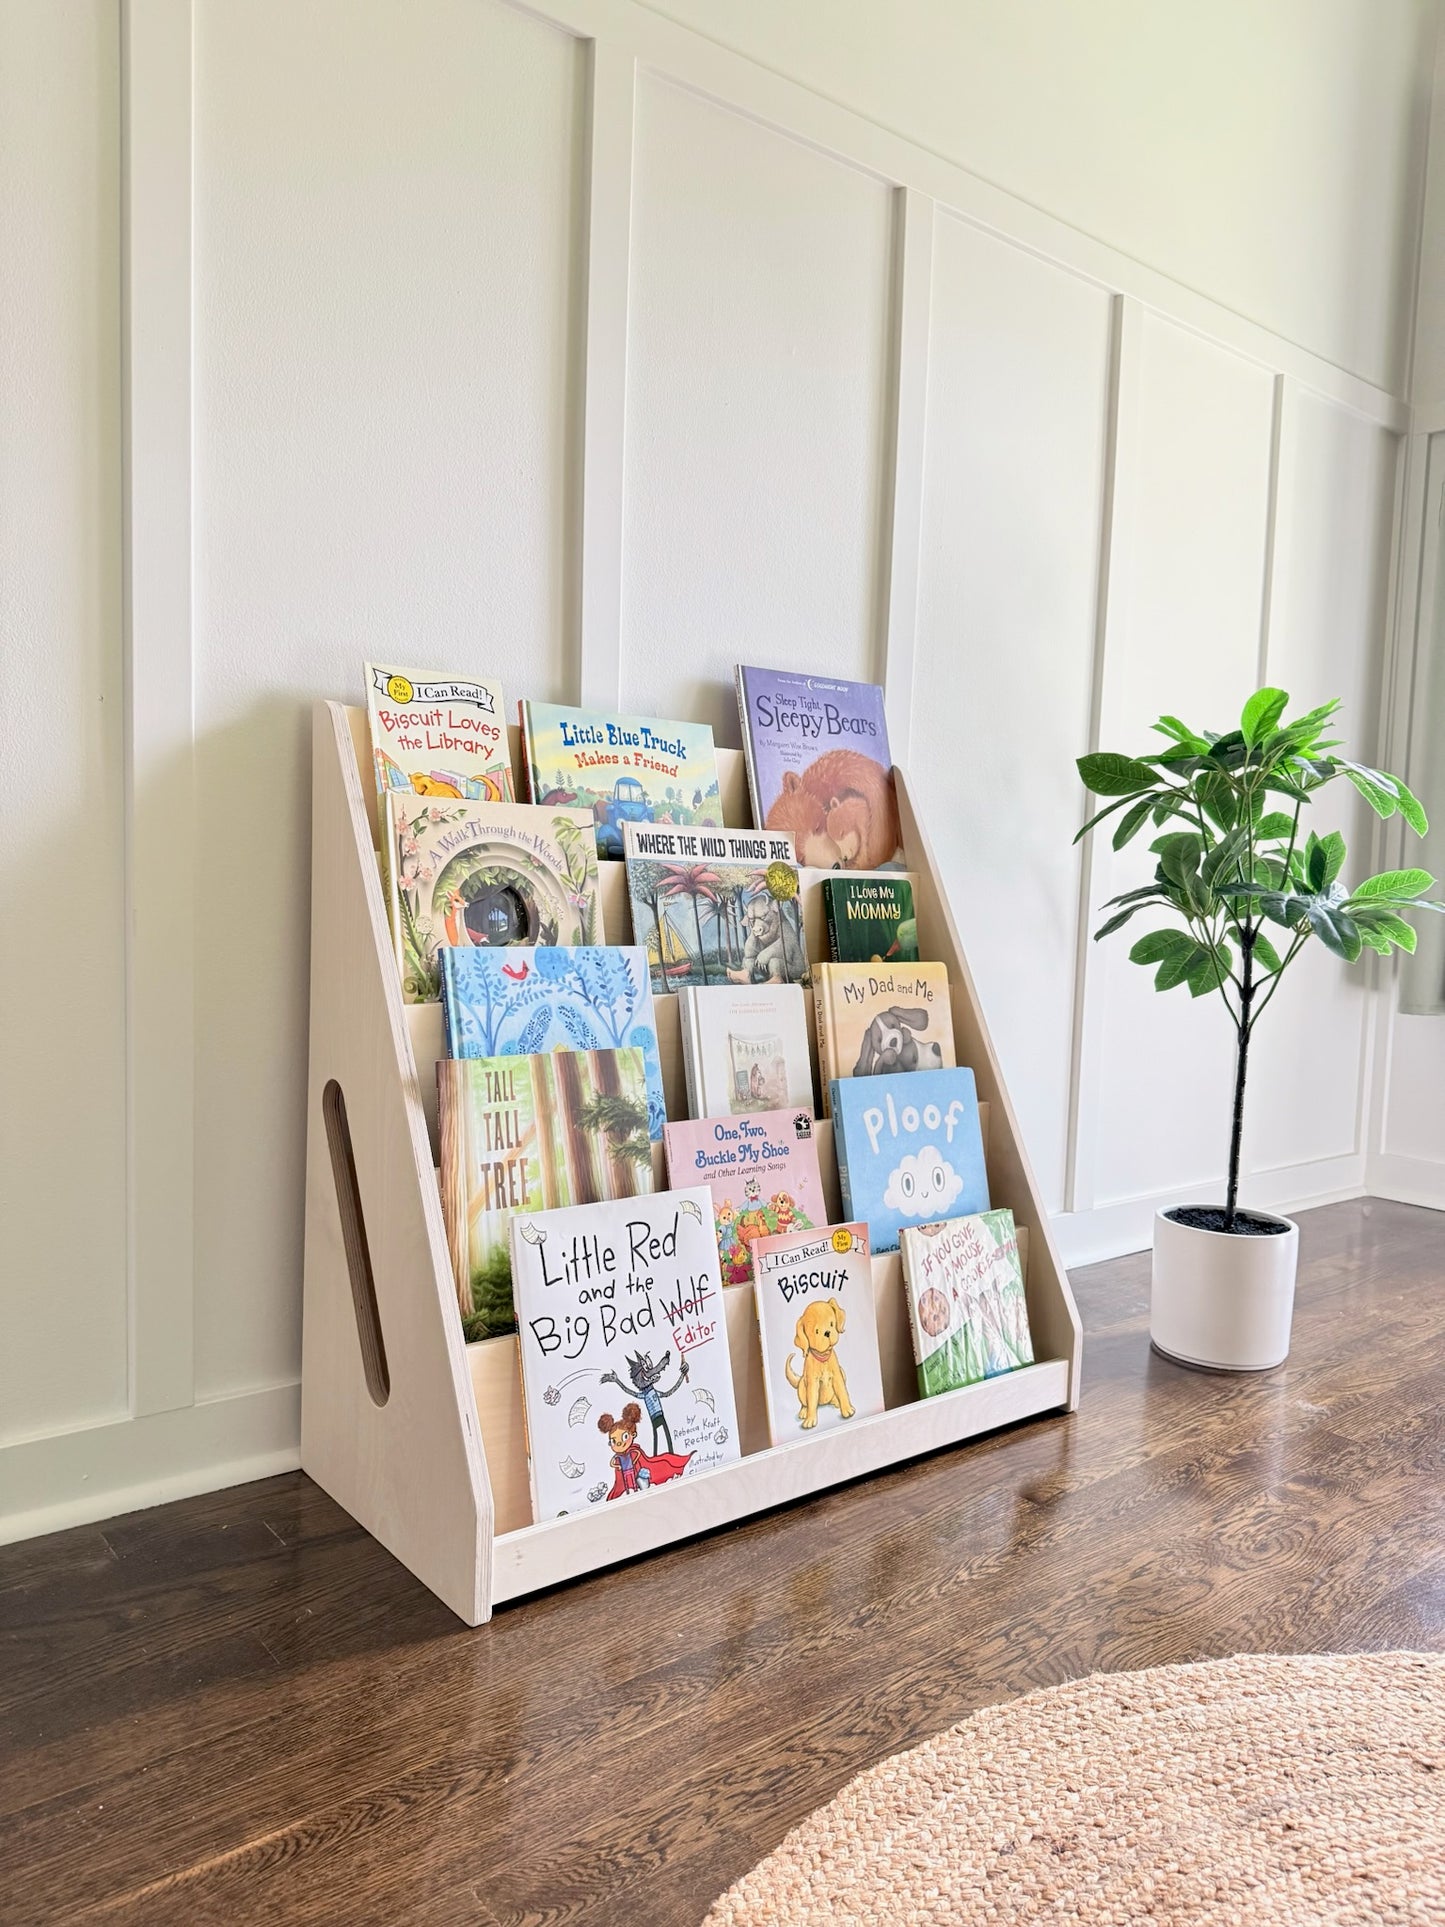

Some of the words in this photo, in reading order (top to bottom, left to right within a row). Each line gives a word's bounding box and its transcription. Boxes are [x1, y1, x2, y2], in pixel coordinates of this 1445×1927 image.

[417, 687, 421, 698] I
[425, 687, 448, 699] Can
[450, 686, 483, 700] Read!
[775, 693, 797, 710] Sleep
[379, 709, 443, 732] Biscuit
[449, 710, 500, 741] Loves
[756, 695, 823, 738] Sleepy
[824, 703, 877, 737] Bears
[397, 734, 422, 750] the
[426, 731, 494, 760] Library
[560, 722, 603, 746] Little
[606, 723, 640, 746] Blue
[640, 727, 687, 759] Truck
[574, 751, 619, 769] Makes
[623, 754, 631, 765] a
[634, 752, 678, 778] Friend
[428, 849, 442, 869] A
[437, 830, 470, 852] Walk
[466, 818, 516, 842] Through
[518, 831, 533, 844] the
[532, 835, 565, 872] Woods
[636, 833, 676, 855] WHERE
[677, 836, 697, 856] THE
[700, 837, 726, 858] WILD
[729, 839, 767, 859] THINGS
[769, 841, 791, 860] ARE
[850, 886, 855, 899] I
[843, 982, 865, 1004] My
[869, 976, 895, 996] Dad
[897, 983, 913, 994] and
[915, 979, 934, 1002] Me
[485, 1070, 516, 1103] TALL
[483, 1109, 523, 1152] TALL
[715, 1124, 741, 1141] One,
[740, 1121, 767, 1138] Two,
[863, 1092, 964, 1155] ploof
[695, 1151, 736, 1168] Buckle
[738, 1144, 760, 1163] My
[761, 1141, 790, 1159] Shoe
[481, 1157, 531, 1211] TREE
[703, 1170, 717, 1180] and
[718, 1167, 736, 1179] Other
[738, 1163, 766, 1175] Learning
[767, 1162, 786, 1171] Songs
[539, 1234, 616, 1286] Little
[625, 1211, 679, 1272] Red
[775, 1256, 780, 1266] I
[781, 1253, 801, 1265] Can
[802, 1241, 829, 1258] Read!
[921, 1253, 933, 1277] IF
[932, 1239, 951, 1265] YOU
[951, 1222, 975, 1248] GIVE
[951, 1239, 984, 1274] MOUSE
[578, 1279, 615, 1304] and
[626, 1273, 654, 1295] the
[778, 1269, 849, 1303] Biscuit
[952, 1287, 959, 1301] A
[529, 1316, 590, 1359] Big
[600, 1292, 655, 1347] Bad
[659, 1274, 709, 1326] Wolf
[672, 1322, 717, 1351] Editor
[673, 1426, 700, 1440] Rebecca
[703, 1417, 720, 1430] Kraft
[687, 1415, 696, 1426] by
[684, 1432, 713, 1448] Rector
